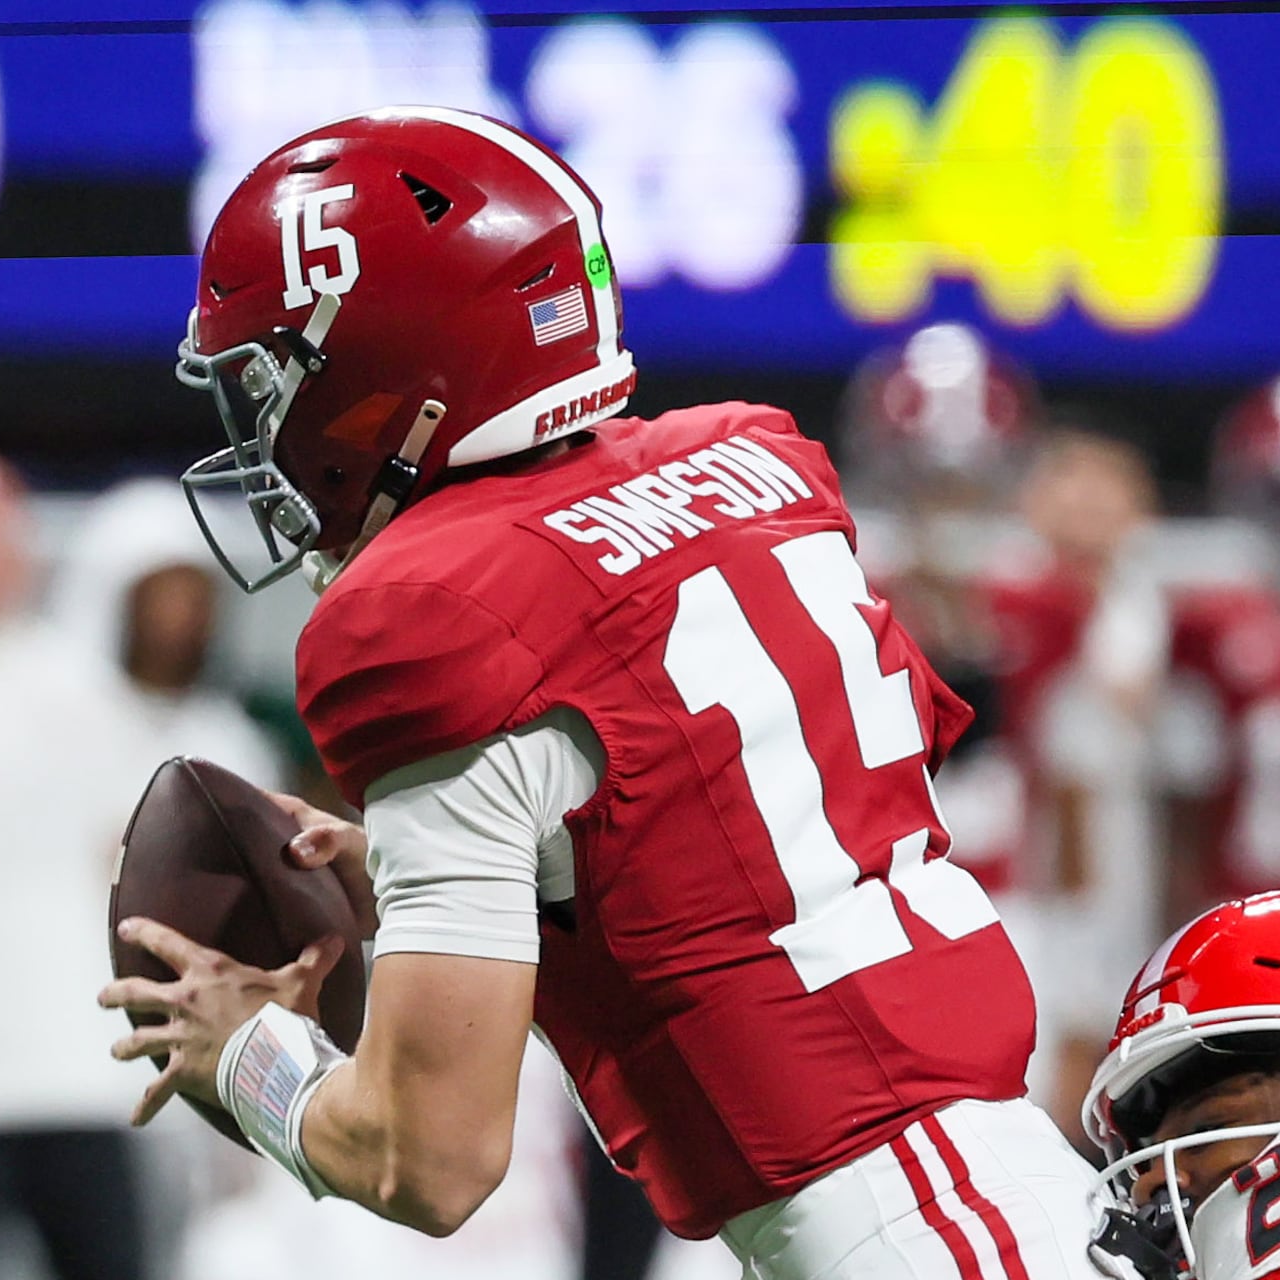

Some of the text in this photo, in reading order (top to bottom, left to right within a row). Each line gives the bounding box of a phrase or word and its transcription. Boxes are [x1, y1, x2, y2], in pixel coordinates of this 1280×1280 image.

[276, 183, 361, 310] 15
[543, 436, 814, 575] SIMPSON
[662, 530, 1001, 993] 15
